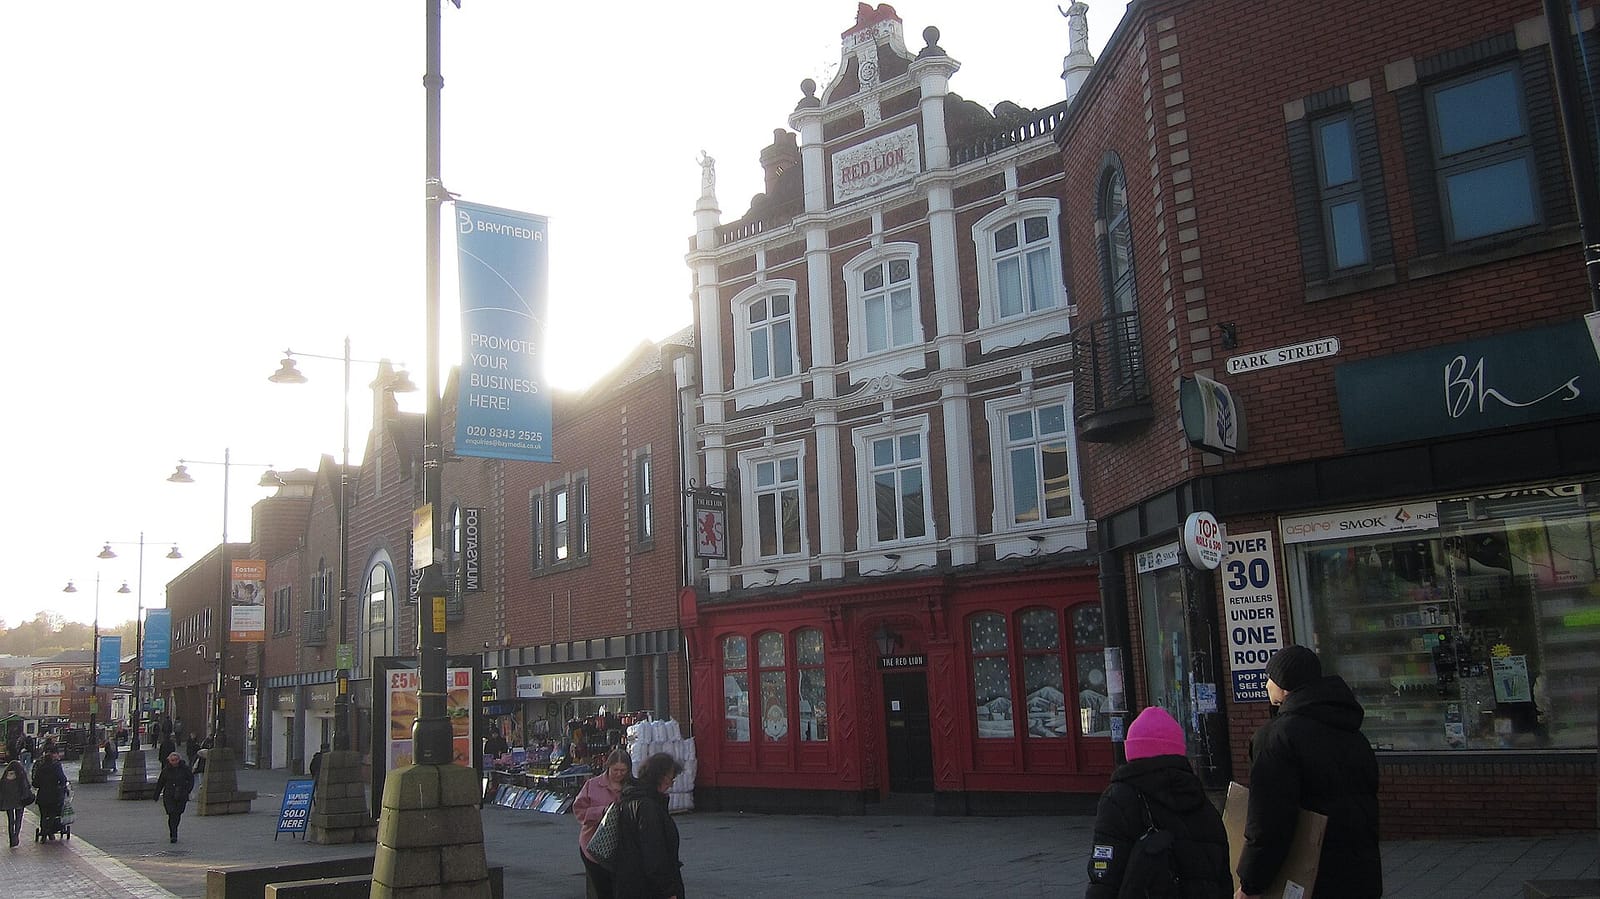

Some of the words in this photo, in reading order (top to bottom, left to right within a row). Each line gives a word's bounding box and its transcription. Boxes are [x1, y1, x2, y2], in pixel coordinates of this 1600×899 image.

[841, 159, 870, 184] RED
[874, 149, 904, 174] LION
[477, 220, 543, 242] BAYMEDIA
[470, 333, 536, 355] PROMOTE
[470, 353, 508, 370] YOUR
[1232, 354, 1268, 371] PARK
[1278, 341, 1332, 362] STREET
[470, 373, 538, 394] BUSINESS
[469, 393, 510, 411] HERE!
[466, 425, 487, 437] 020
[489, 427, 516, 439] 8343
[518, 430, 543, 442] 2525
[1197, 519, 1217, 539] TOP
[1286, 520, 1331, 537] aspire
[1339, 517, 1386, 531] SMOK
[466, 508, 478, 590] FOOTASYLUM
[1195, 535, 1208, 548] NAILS
[1227, 538, 1267, 554] OVER
[1227, 558, 1270, 590] 30
[1230, 594, 1273, 605] RETAILERS
[1231, 608, 1275, 621] UNDER
[1232, 626, 1277, 646] ONE
[882, 658, 894, 667] THE
[895, 657, 907, 666] RED
[908, 656, 923, 666] LION
[391, 673, 408, 689] £5
[1238, 673, 1257, 681] POP
[1236, 690, 1267, 699] YOURS
[1239, 682, 1258, 690] SEE
[283, 809, 306, 818] SOLD
[280, 819, 304, 828] HERE
